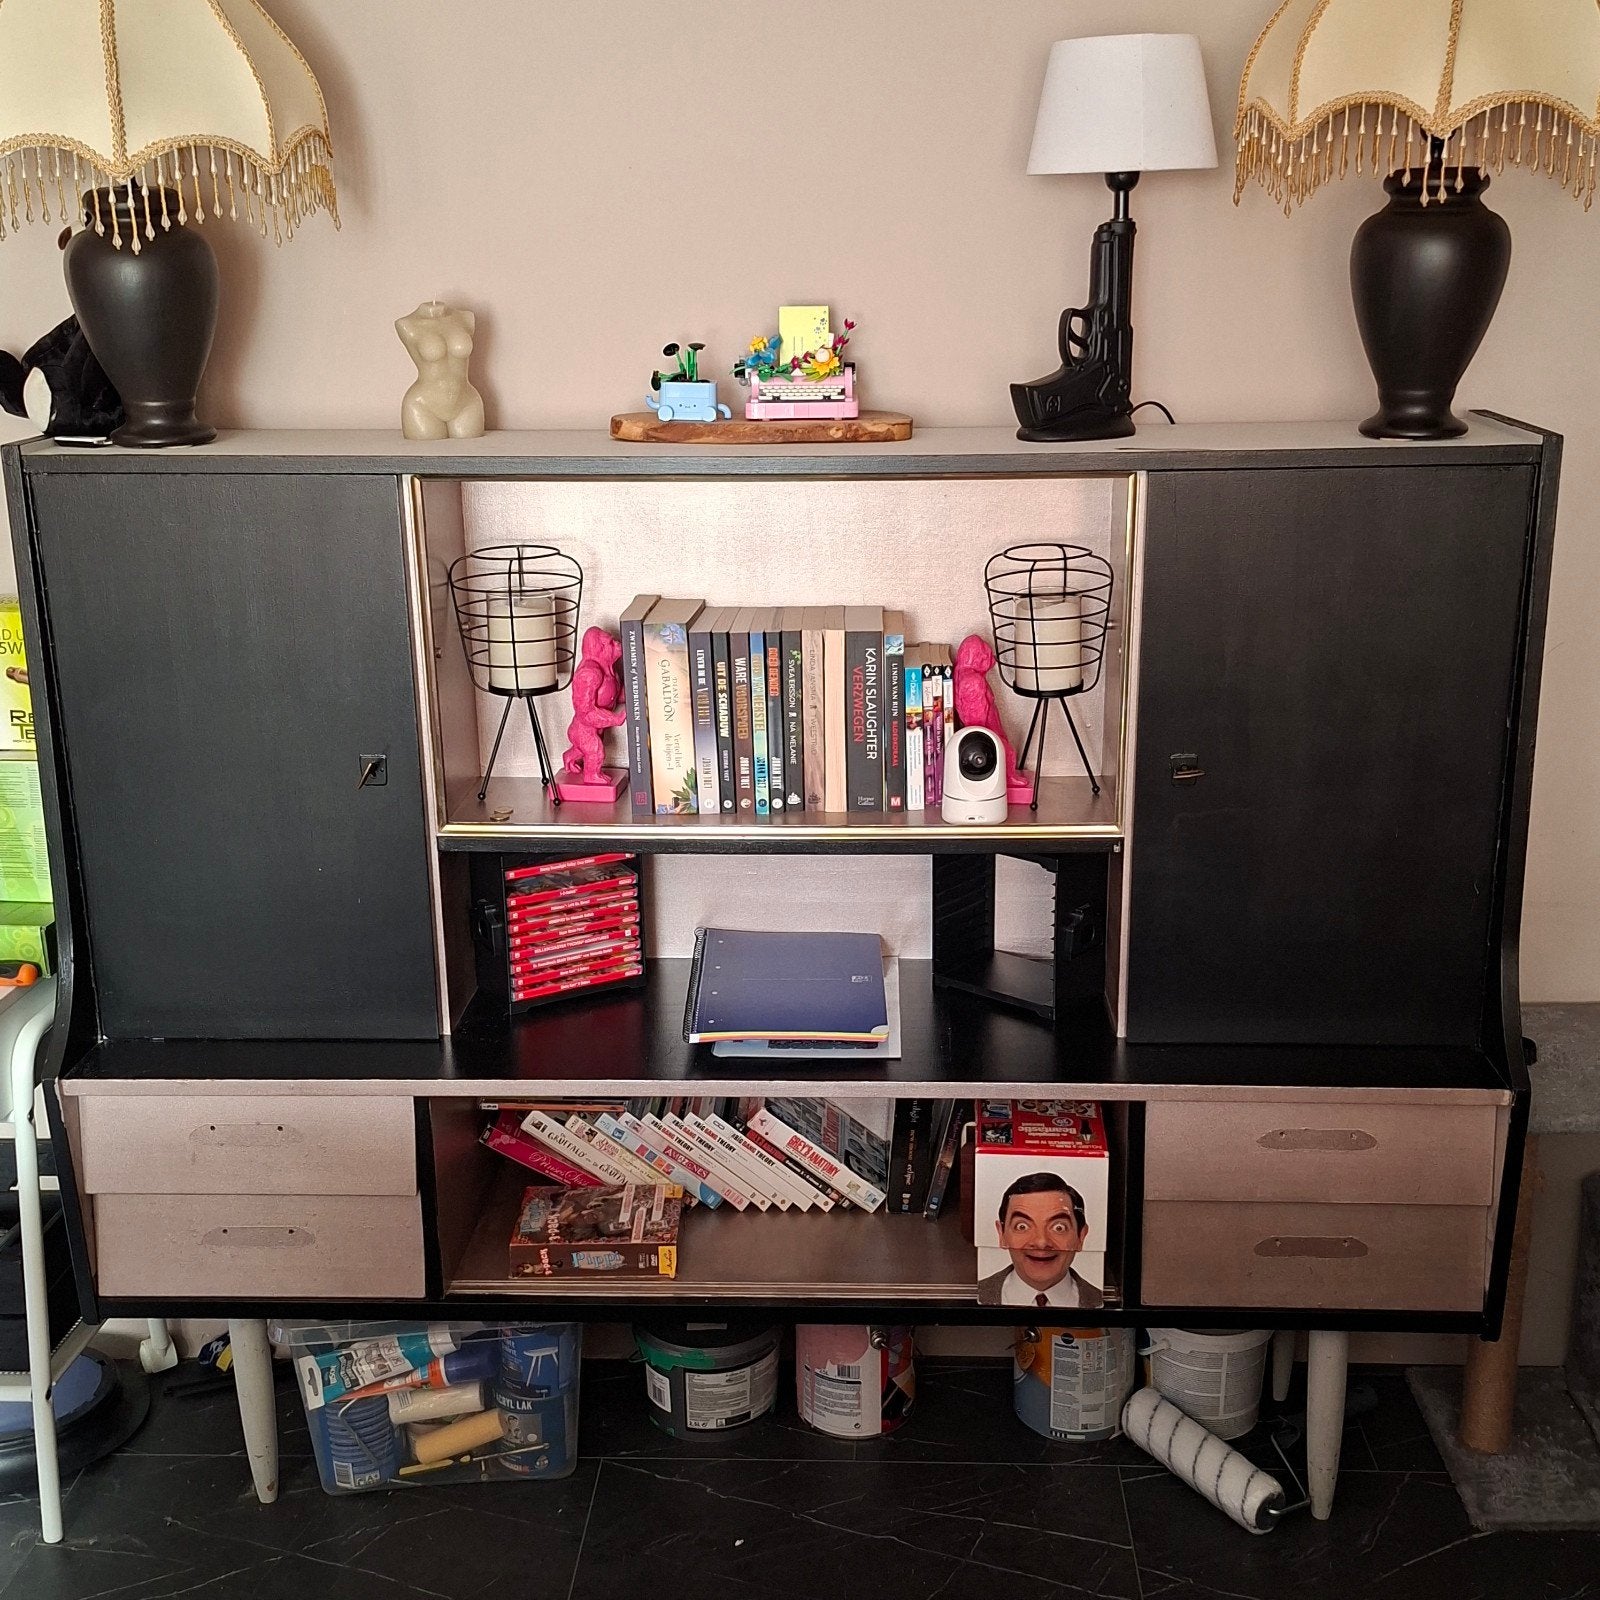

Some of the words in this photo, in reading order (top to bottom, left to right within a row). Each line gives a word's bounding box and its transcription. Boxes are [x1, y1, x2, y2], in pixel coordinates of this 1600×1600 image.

[629, 630, 637, 668] ZWEMMEN
[717, 662, 725, 677] UIT
[735, 657, 747, 683] WARE
[865, 648, 876, 686] KARIN
[658, 659, 675, 722] GABALDON
[718, 678, 726, 690] DE
[788, 679, 796, 708] ERSSON
[632, 675, 640, 721] VERDRINKEN
[853, 666, 864, 742] VERZWEGEN
[890, 701, 899, 716] RIJN
[718, 692, 729, 738] SCHADUW
[789, 722, 796, 732] NA
[866, 688, 878, 760] SLAUGHTER
[789, 735, 797, 765] MELANIE
[674, 1137, 694, 1152] THEORY
[695, 1136, 715, 1152] THEORY
[717, 1137, 736, 1153] THEORY
[547, 1132, 587, 1158] GRUFFALO
[599, 1164, 629, 1185] GRUFFAL
[664, 1147, 708, 1178] AMAZONES
[755, 1150, 775, 1167] THEORY
[808, 1151, 840, 1177] ANATOMY
[571, 1251, 623, 1269] Pippi
[516, 1401, 532, 1410] LAK
